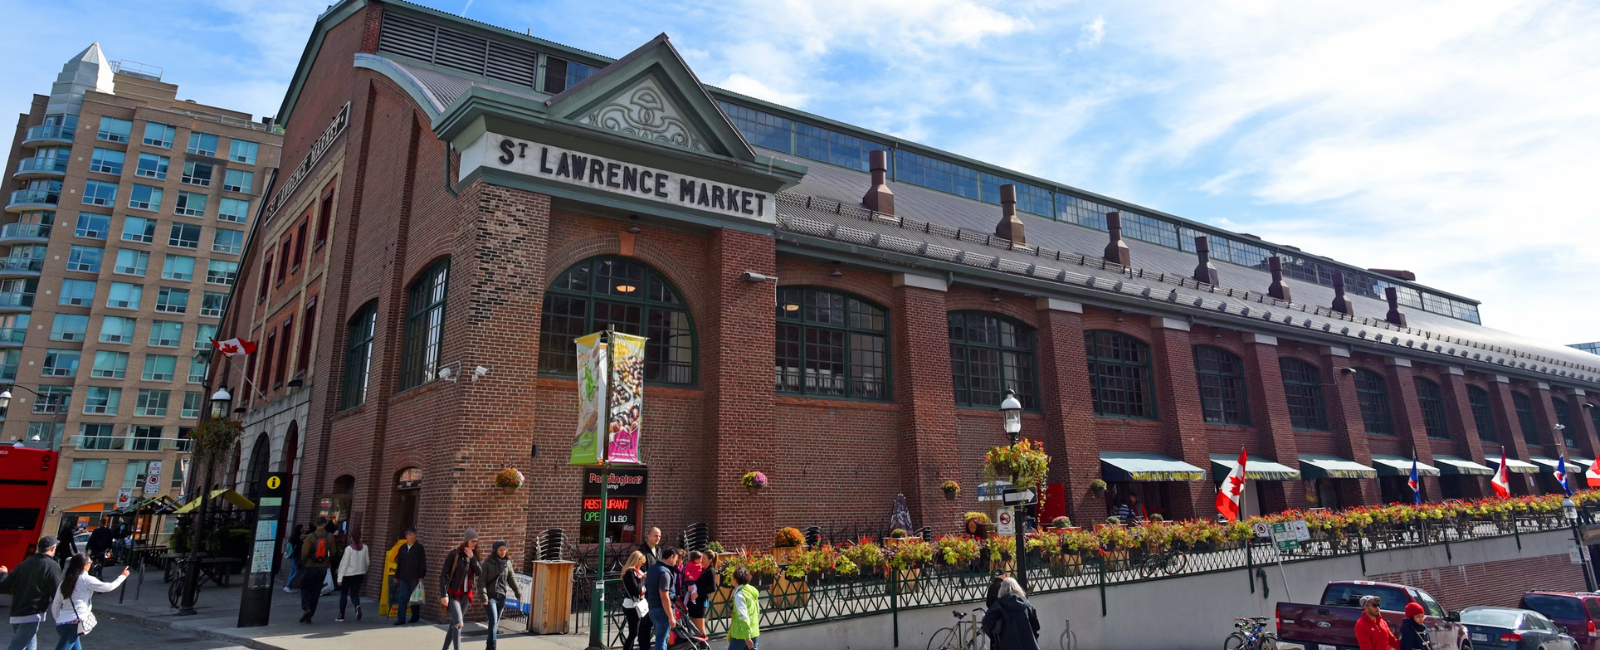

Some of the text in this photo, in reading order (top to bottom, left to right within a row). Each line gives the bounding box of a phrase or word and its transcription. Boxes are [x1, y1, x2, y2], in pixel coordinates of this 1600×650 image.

[540, 147, 669, 198] LAWRENCE
[680, 178, 766, 216] MARKET
[584, 499, 629, 509] RESTURANT
[584, 512, 601, 522] OPE
